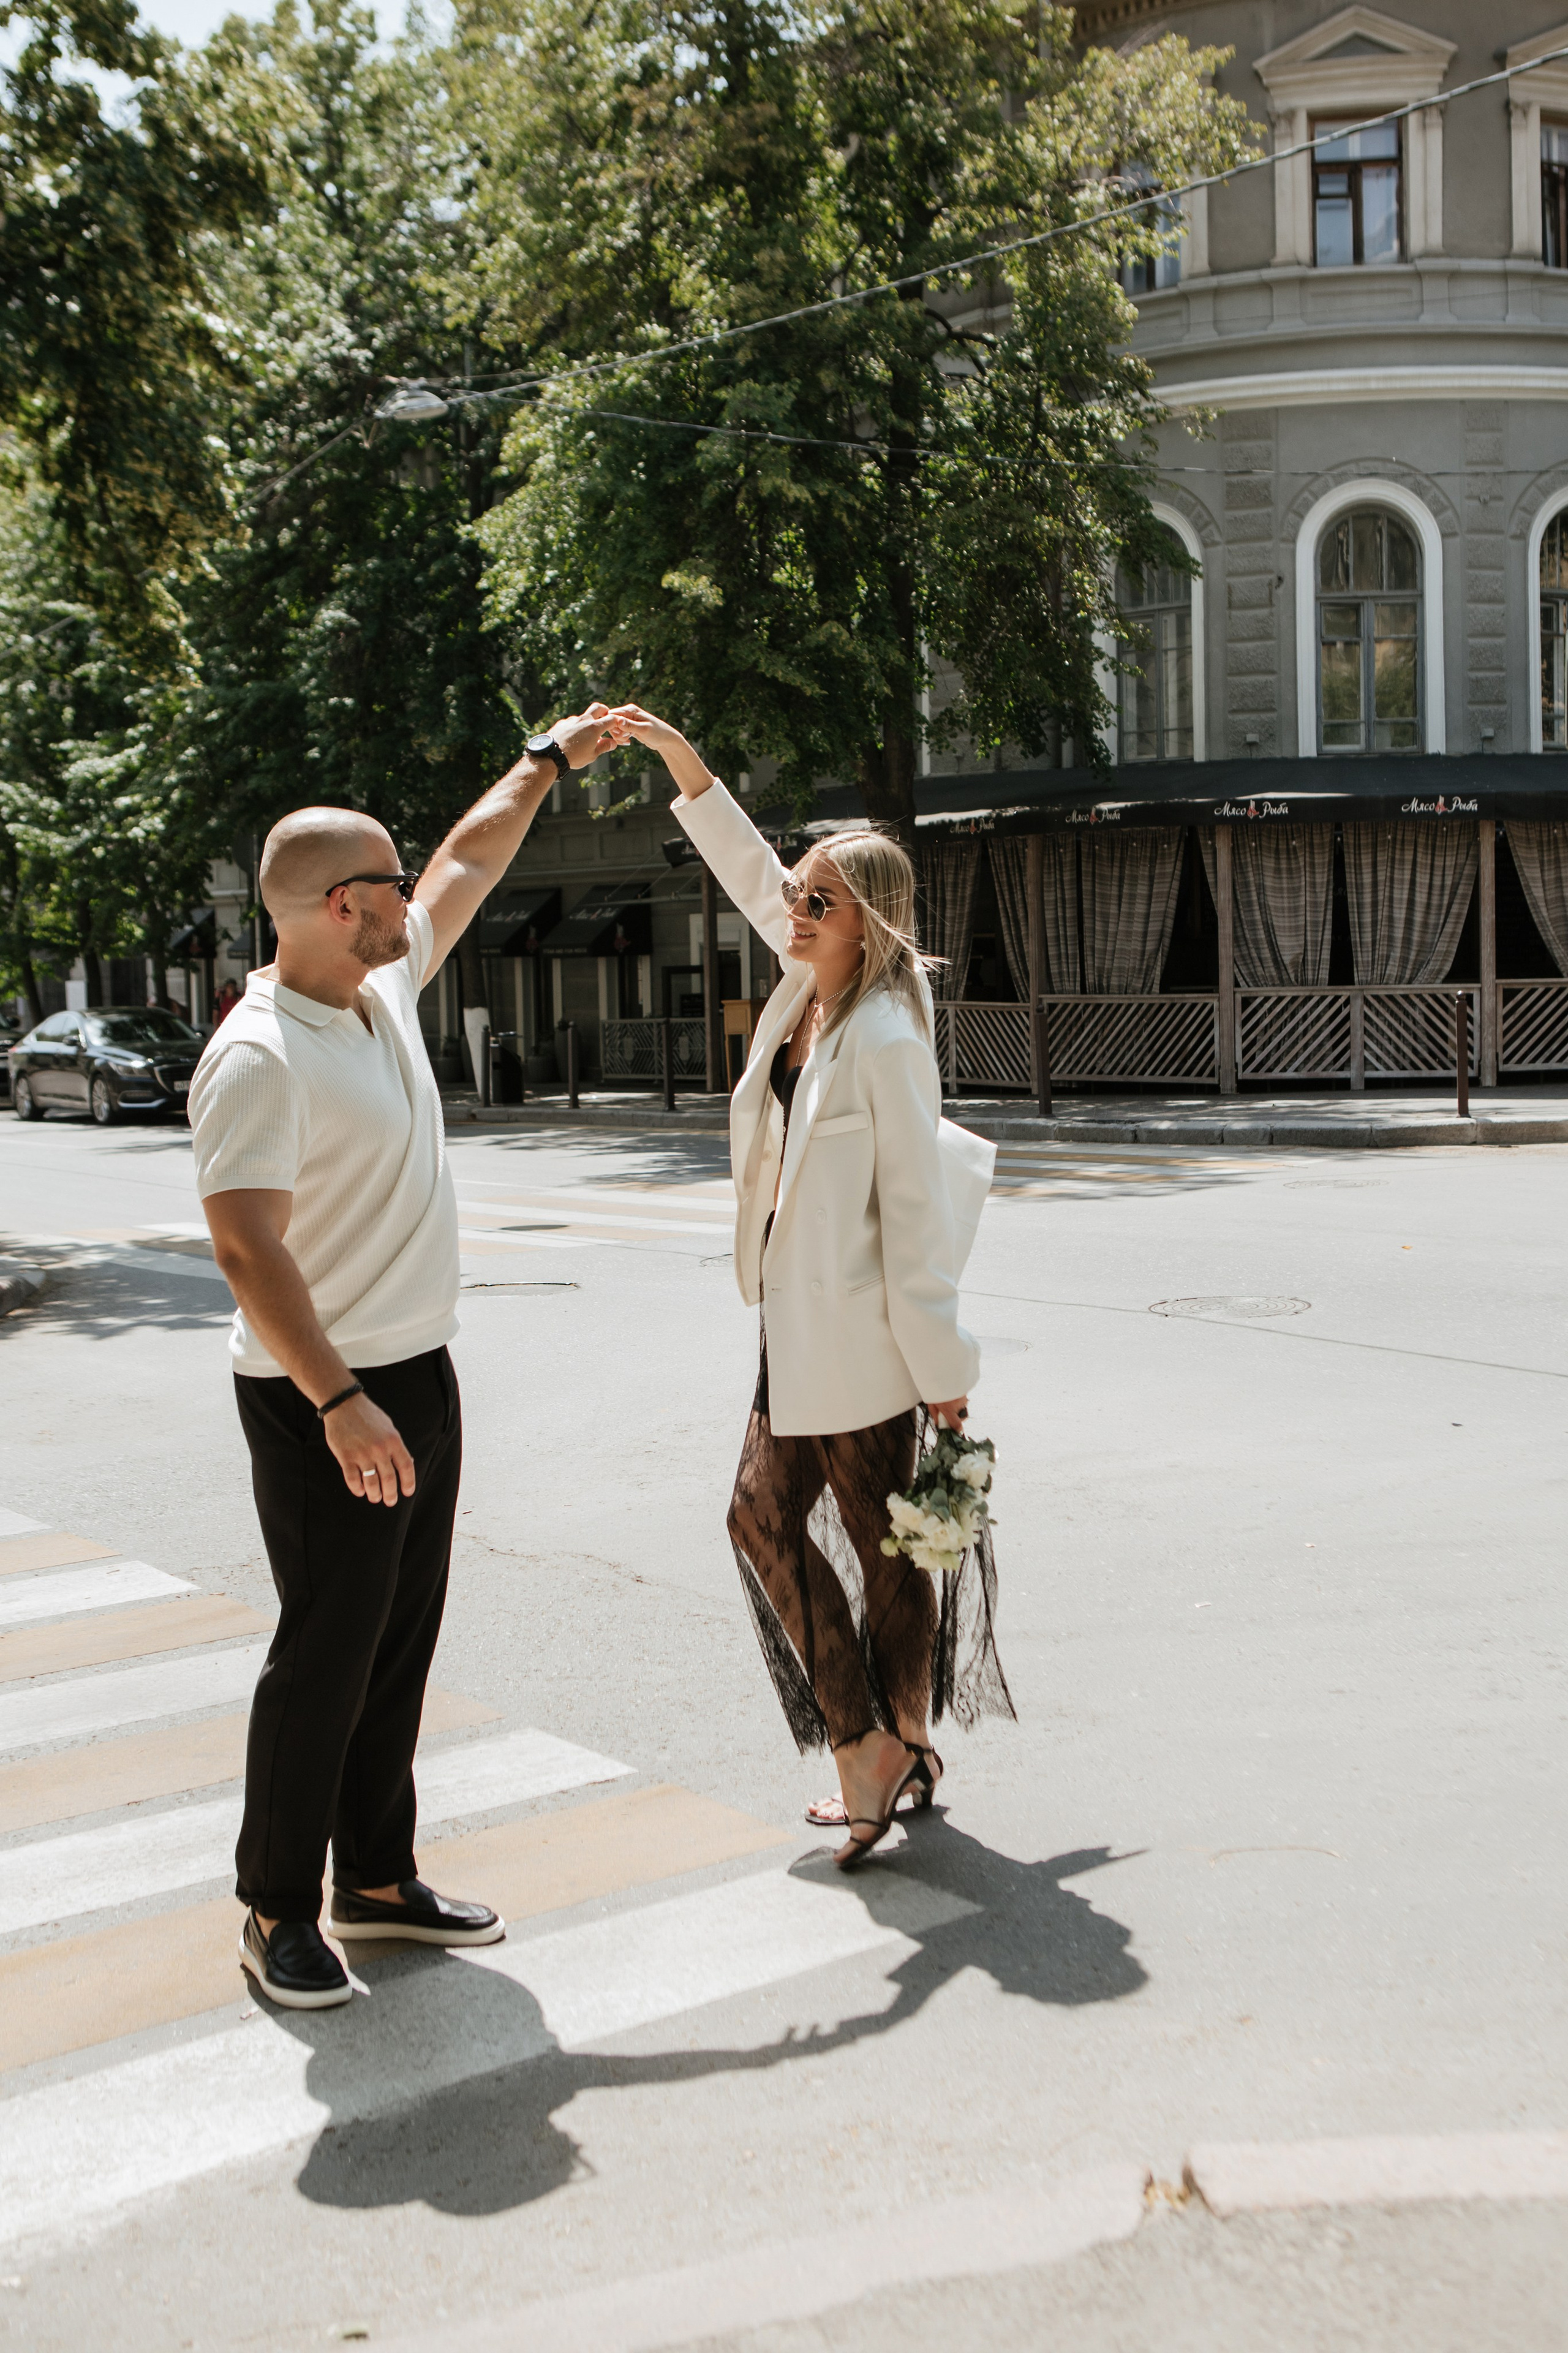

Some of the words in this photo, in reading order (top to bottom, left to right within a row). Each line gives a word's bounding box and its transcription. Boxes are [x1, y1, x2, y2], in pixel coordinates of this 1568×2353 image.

[1214, 801, 1246, 817] Мясо
[1259, 801, 1289, 818] Рыба
[1401, 796, 1435, 814] Мясо
[1447, 796, 1478, 814] Рыба
[1065, 809, 1090, 823] Мясо
